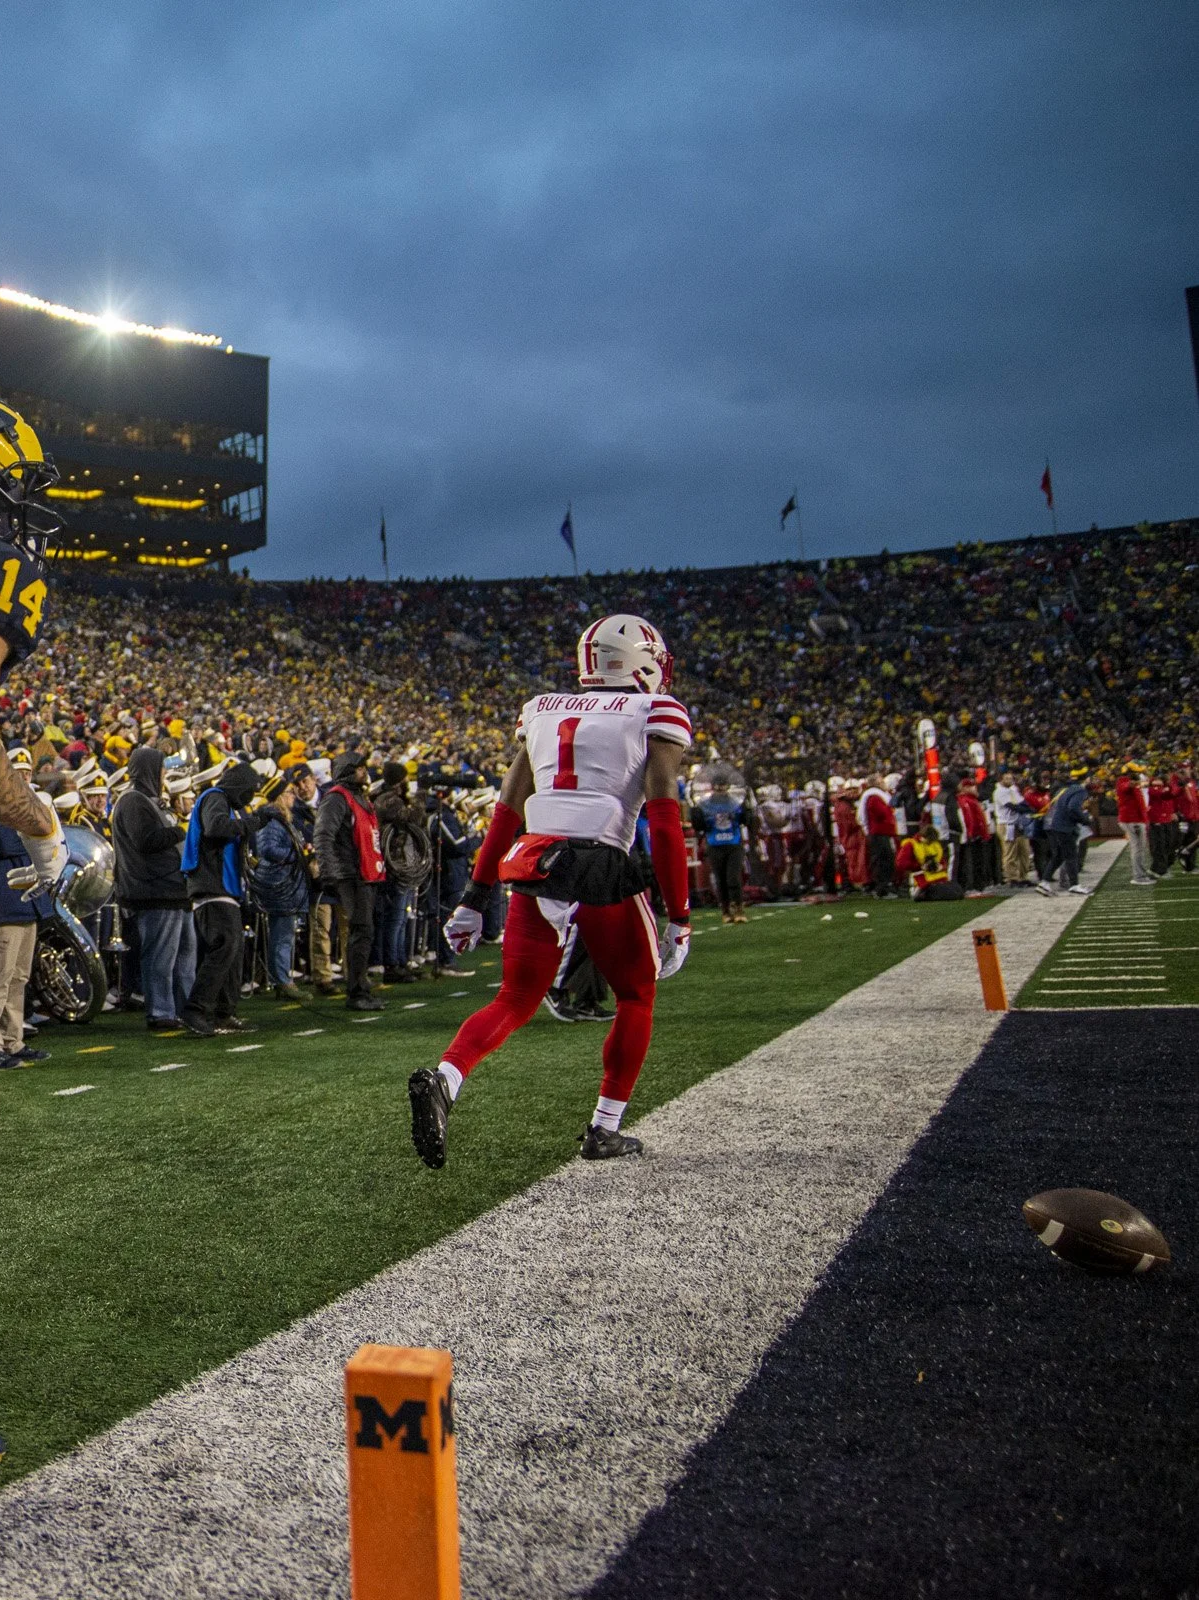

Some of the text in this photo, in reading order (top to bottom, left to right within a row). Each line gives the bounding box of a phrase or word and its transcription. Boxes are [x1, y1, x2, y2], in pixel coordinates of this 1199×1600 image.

[537, 696, 630, 713] BUFORD JR
[552, 717, 582, 790] 1
[976, 934, 993, 947] M
[353, 1394, 429, 1455] M
